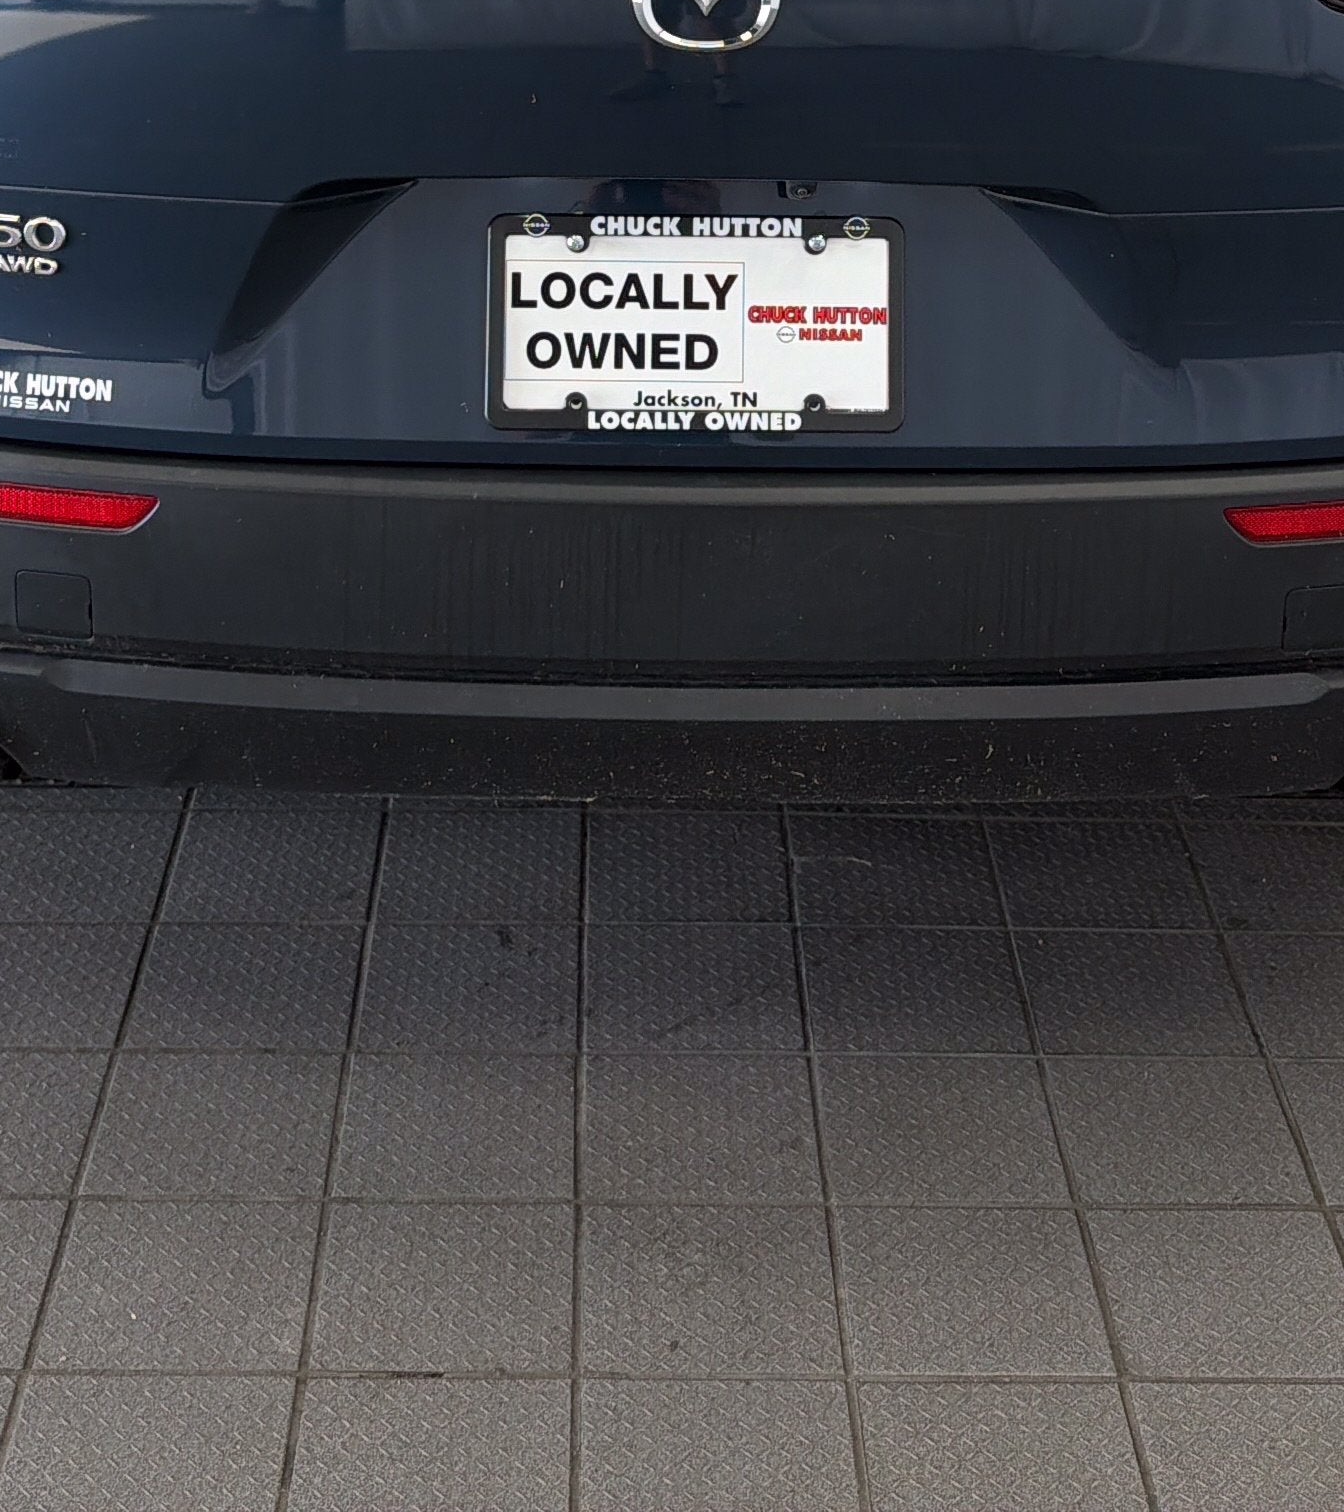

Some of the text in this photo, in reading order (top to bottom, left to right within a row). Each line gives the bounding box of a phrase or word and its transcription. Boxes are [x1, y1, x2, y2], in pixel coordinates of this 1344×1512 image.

[590, 215, 803, 237] CHUCK HUTTON
[511, 272, 738, 310] LOCALLY
[748, 305, 888, 325] CHUCK HUTTON
[798, 327, 863, 341] NISSAN
[525, 331, 719, 370] OWNED
[26, 373, 113, 402] HUTTON
[632, 389, 758, 409] Jackson, TN
[587, 410, 803, 431] LOCALLY OWNED
